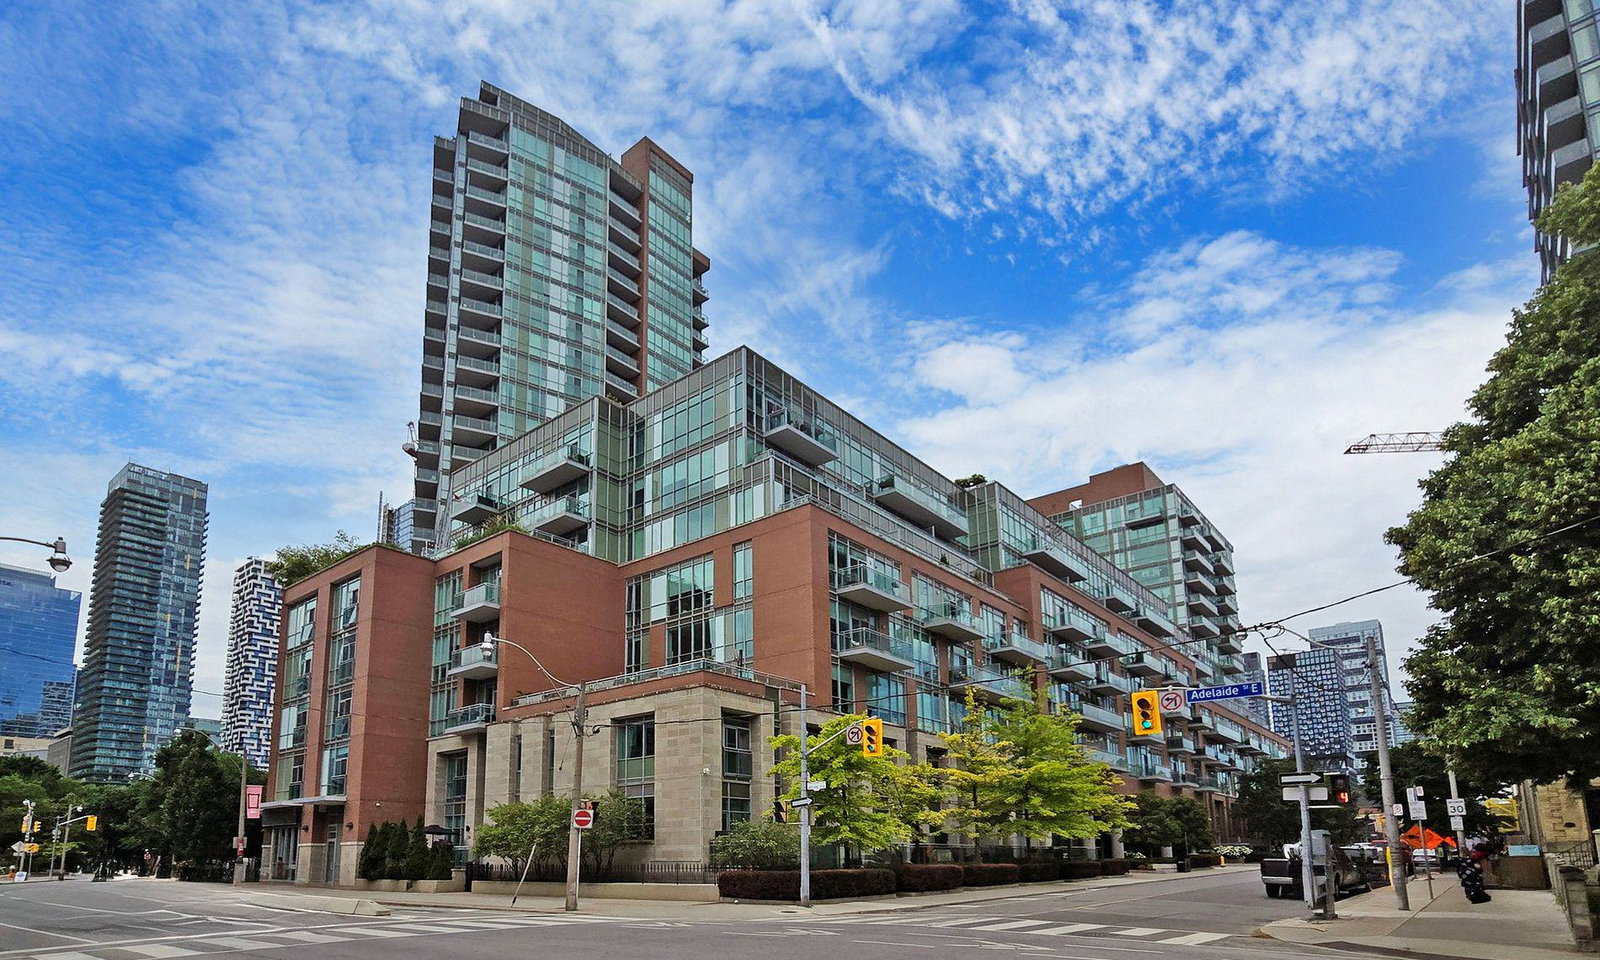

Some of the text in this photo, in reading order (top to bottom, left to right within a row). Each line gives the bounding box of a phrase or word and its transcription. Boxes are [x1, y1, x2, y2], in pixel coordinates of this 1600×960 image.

[1191, 687, 1239, 700] Adelaide
[1251, 683, 1259, 693] E
[1449, 805, 1464, 814] 30
